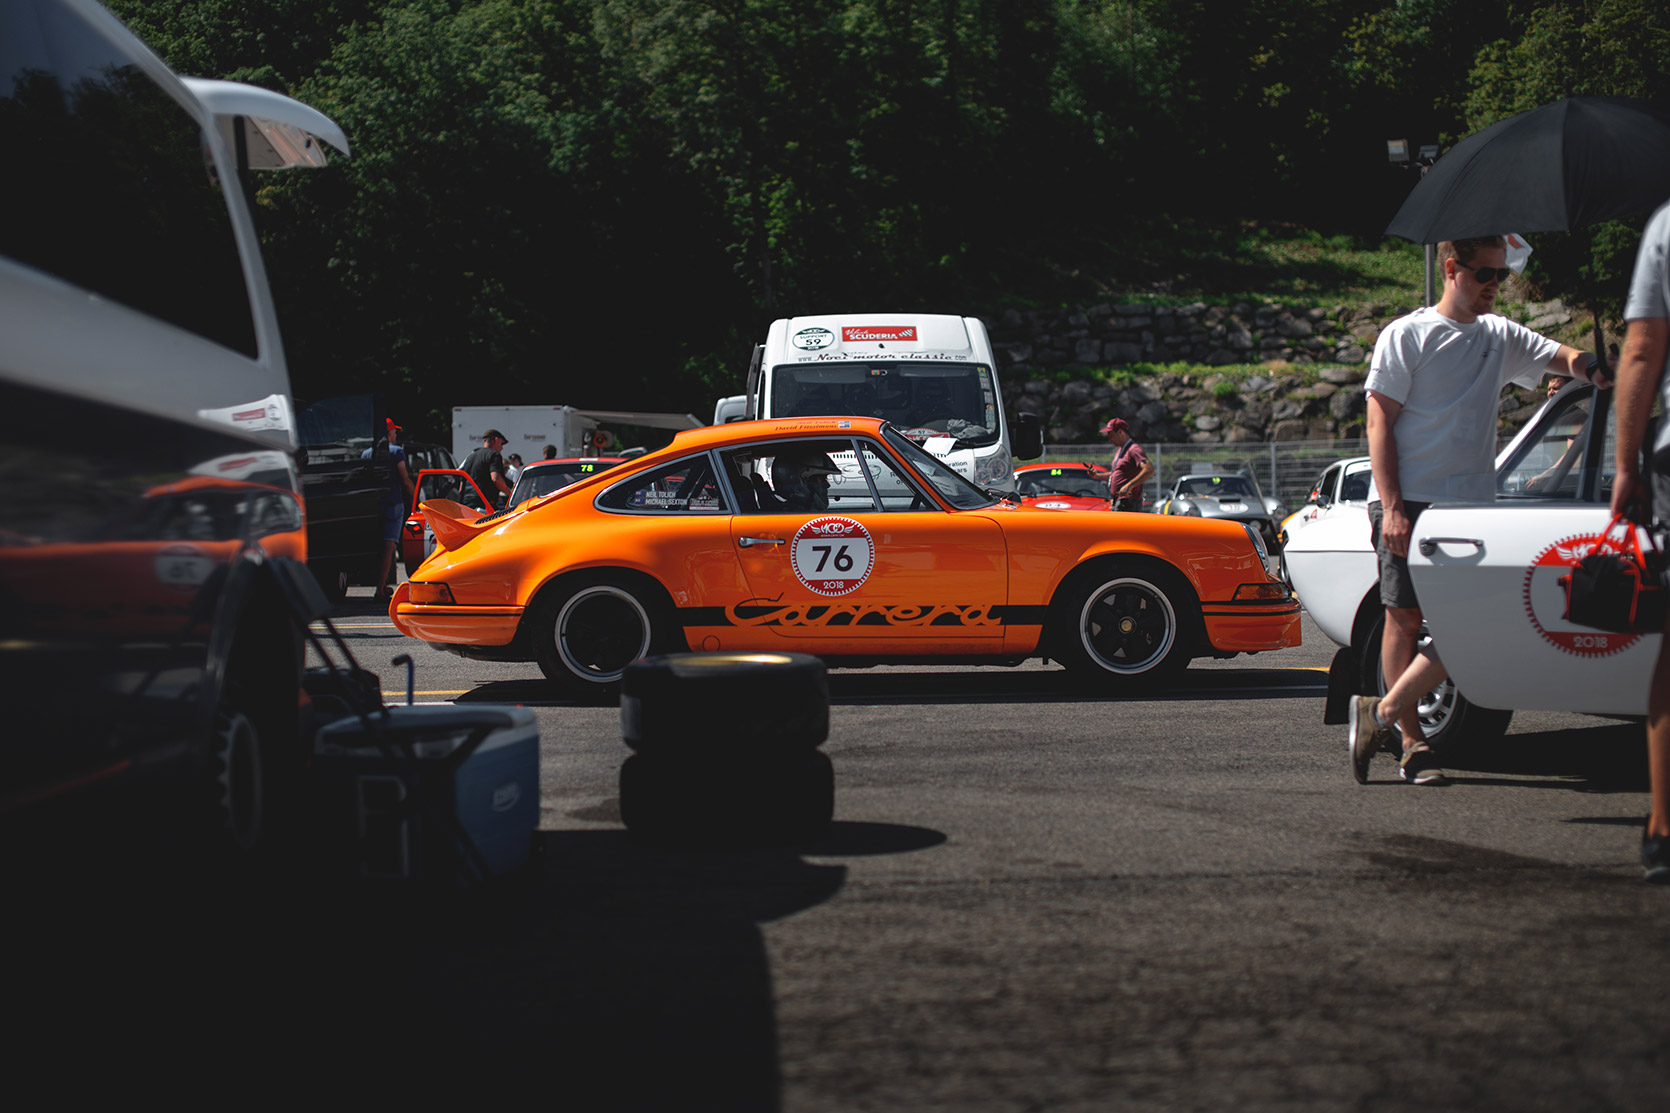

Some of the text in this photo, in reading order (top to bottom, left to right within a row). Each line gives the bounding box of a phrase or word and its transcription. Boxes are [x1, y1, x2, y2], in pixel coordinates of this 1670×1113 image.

[805, 338, 822, 346] 59
[580, 464, 594, 472] 78
[812, 545, 854, 573] 76
[823, 581, 844, 590] 2018
[724, 592, 1002, 627] Carrera
[1573, 635, 1608, 649] 2018
